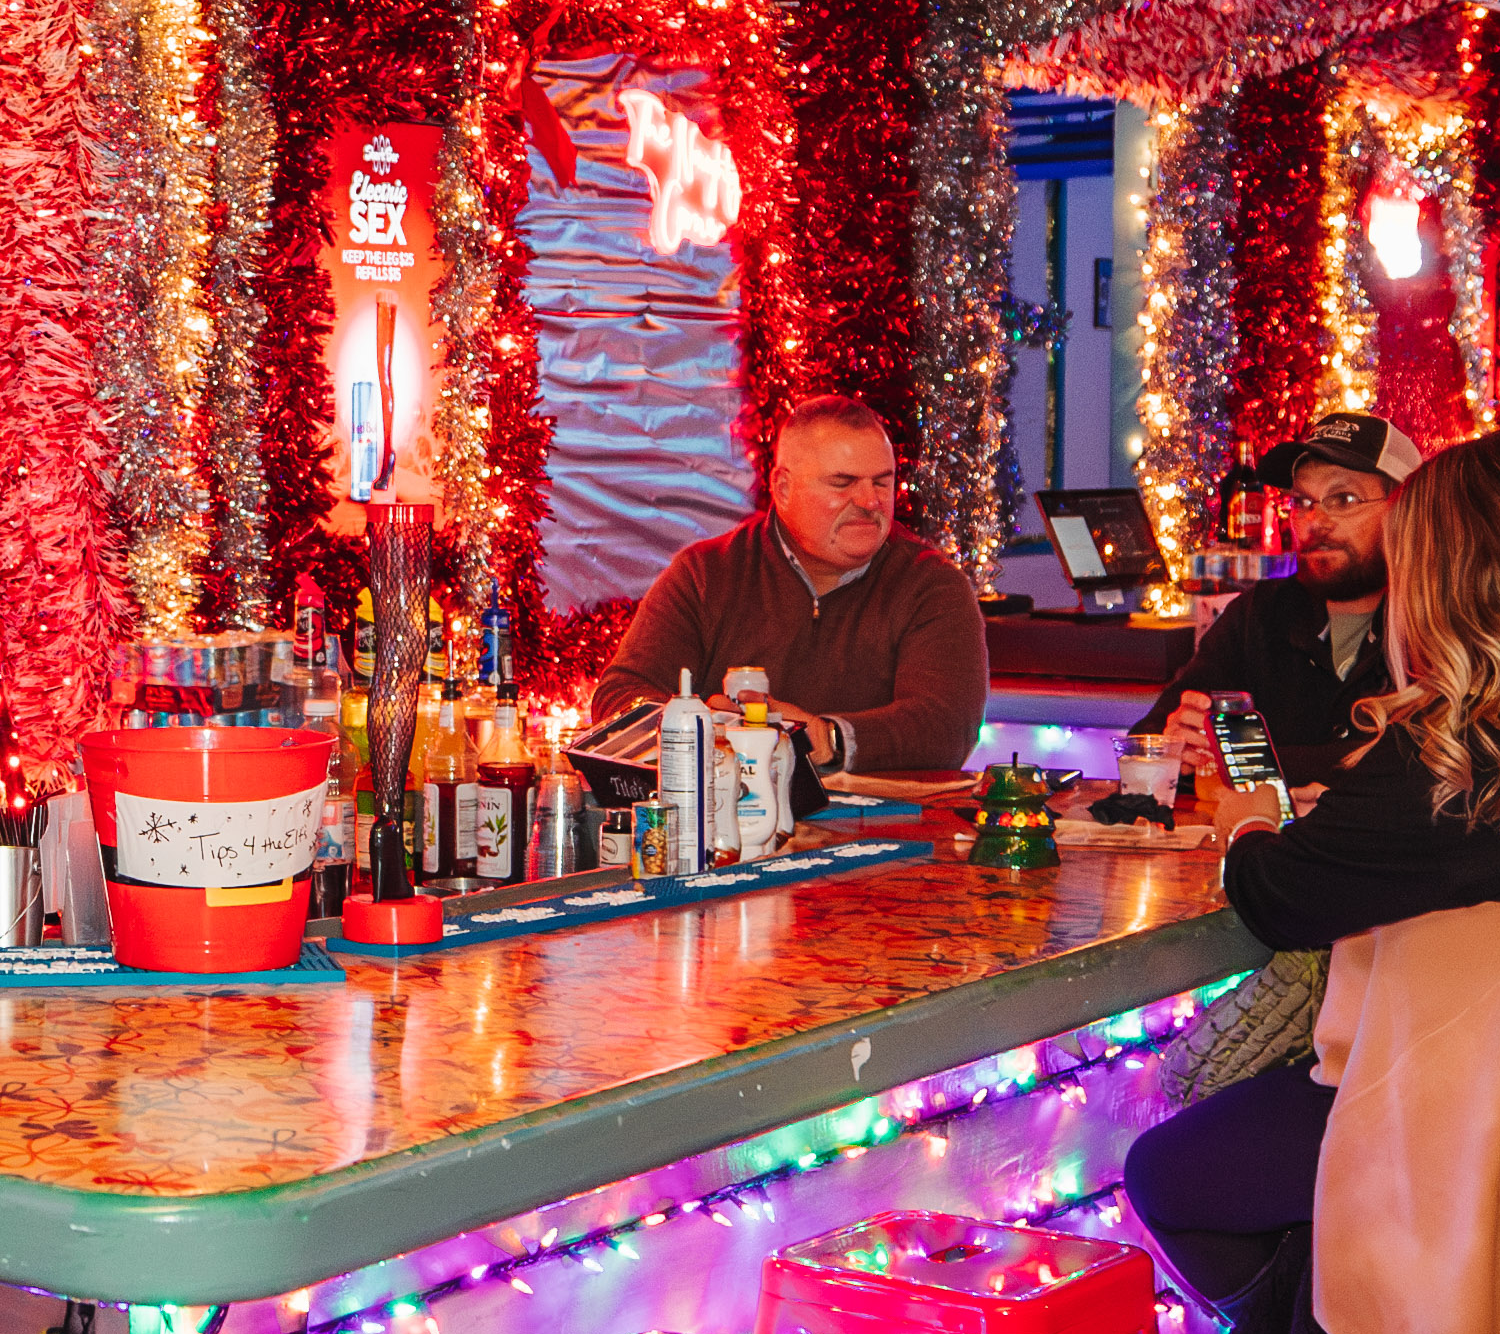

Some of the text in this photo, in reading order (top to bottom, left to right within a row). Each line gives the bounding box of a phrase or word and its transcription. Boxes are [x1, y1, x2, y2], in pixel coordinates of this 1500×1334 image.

[350, 170, 408, 204] Electric
[349, 201, 408, 246] SEX
[342, 249, 365, 264] KEEP
[365, 250, 383, 265] THE
[382, 251, 399, 266] LEG
[355, 265, 388, 282] REFILLS
[189, 831, 239, 867] Tips
[243, 835, 257, 855] 4
[261, 837, 283, 853] the
